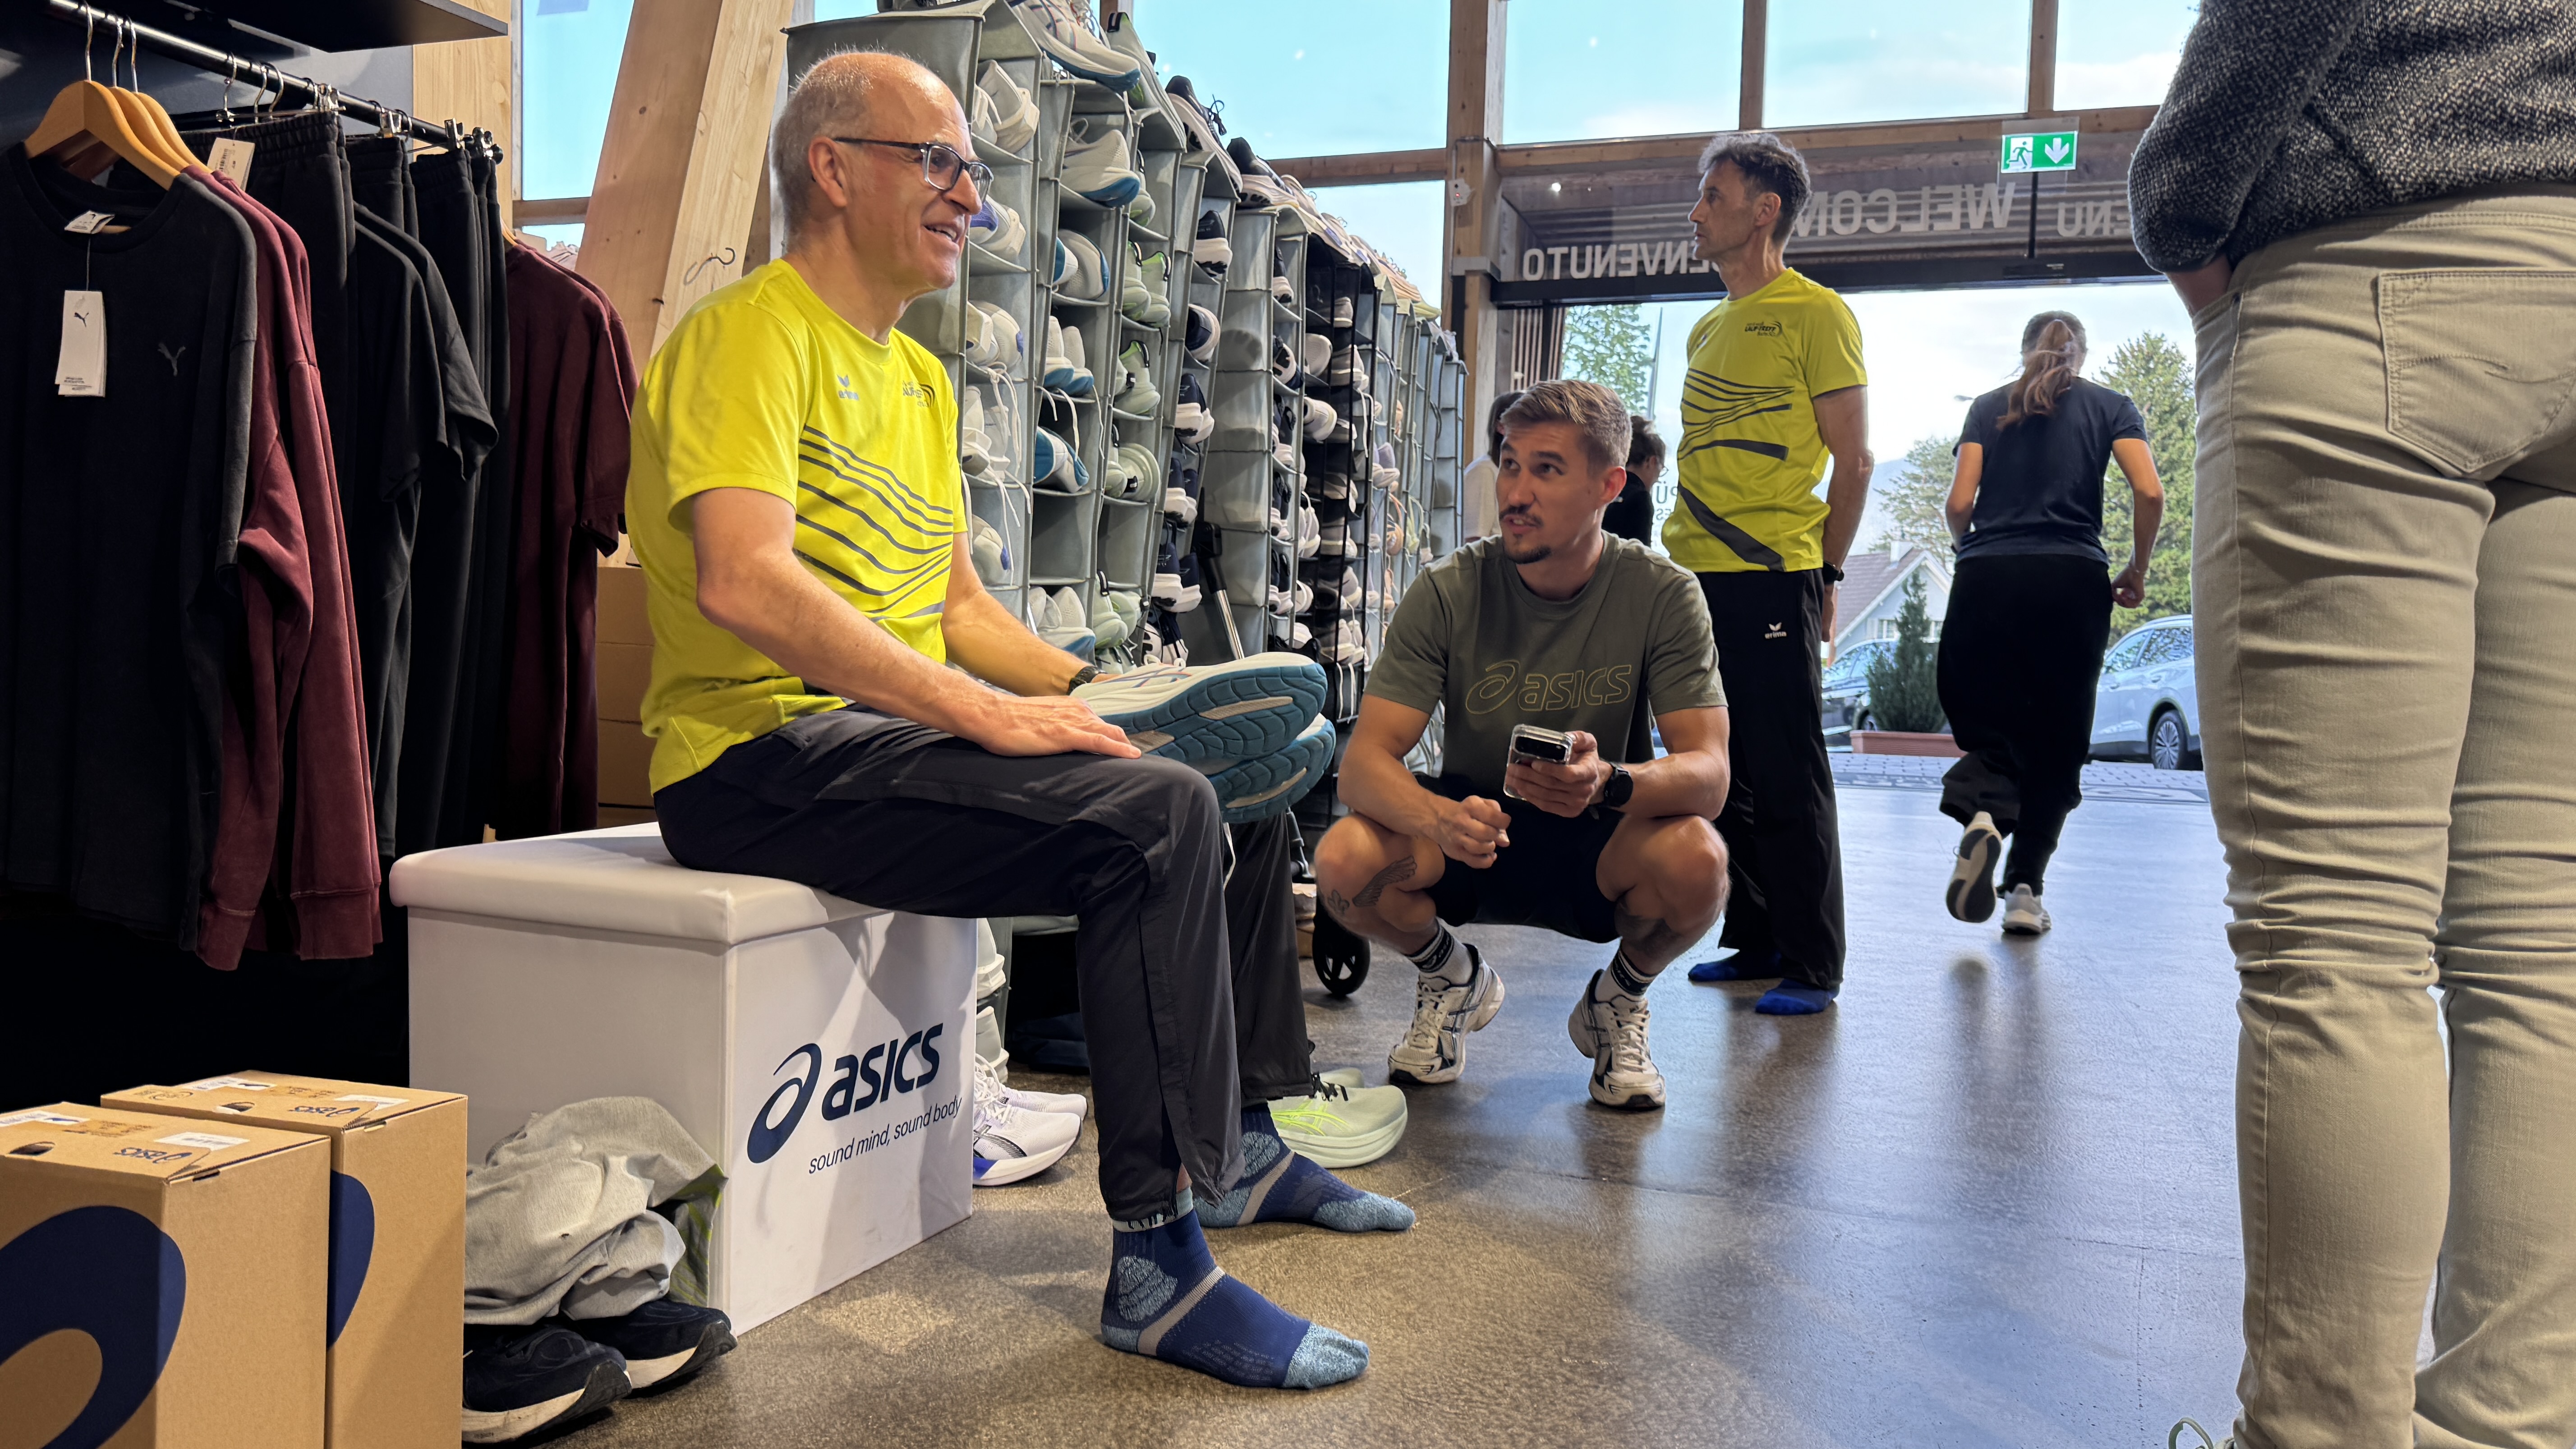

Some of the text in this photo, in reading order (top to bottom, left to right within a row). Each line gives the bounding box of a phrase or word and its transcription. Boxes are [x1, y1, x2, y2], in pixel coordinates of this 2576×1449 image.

[1518, 664, 1632, 712] asics
[822, 1022, 943, 1121] asics
[809, 1095, 962, 1174] sound mind, sound body
